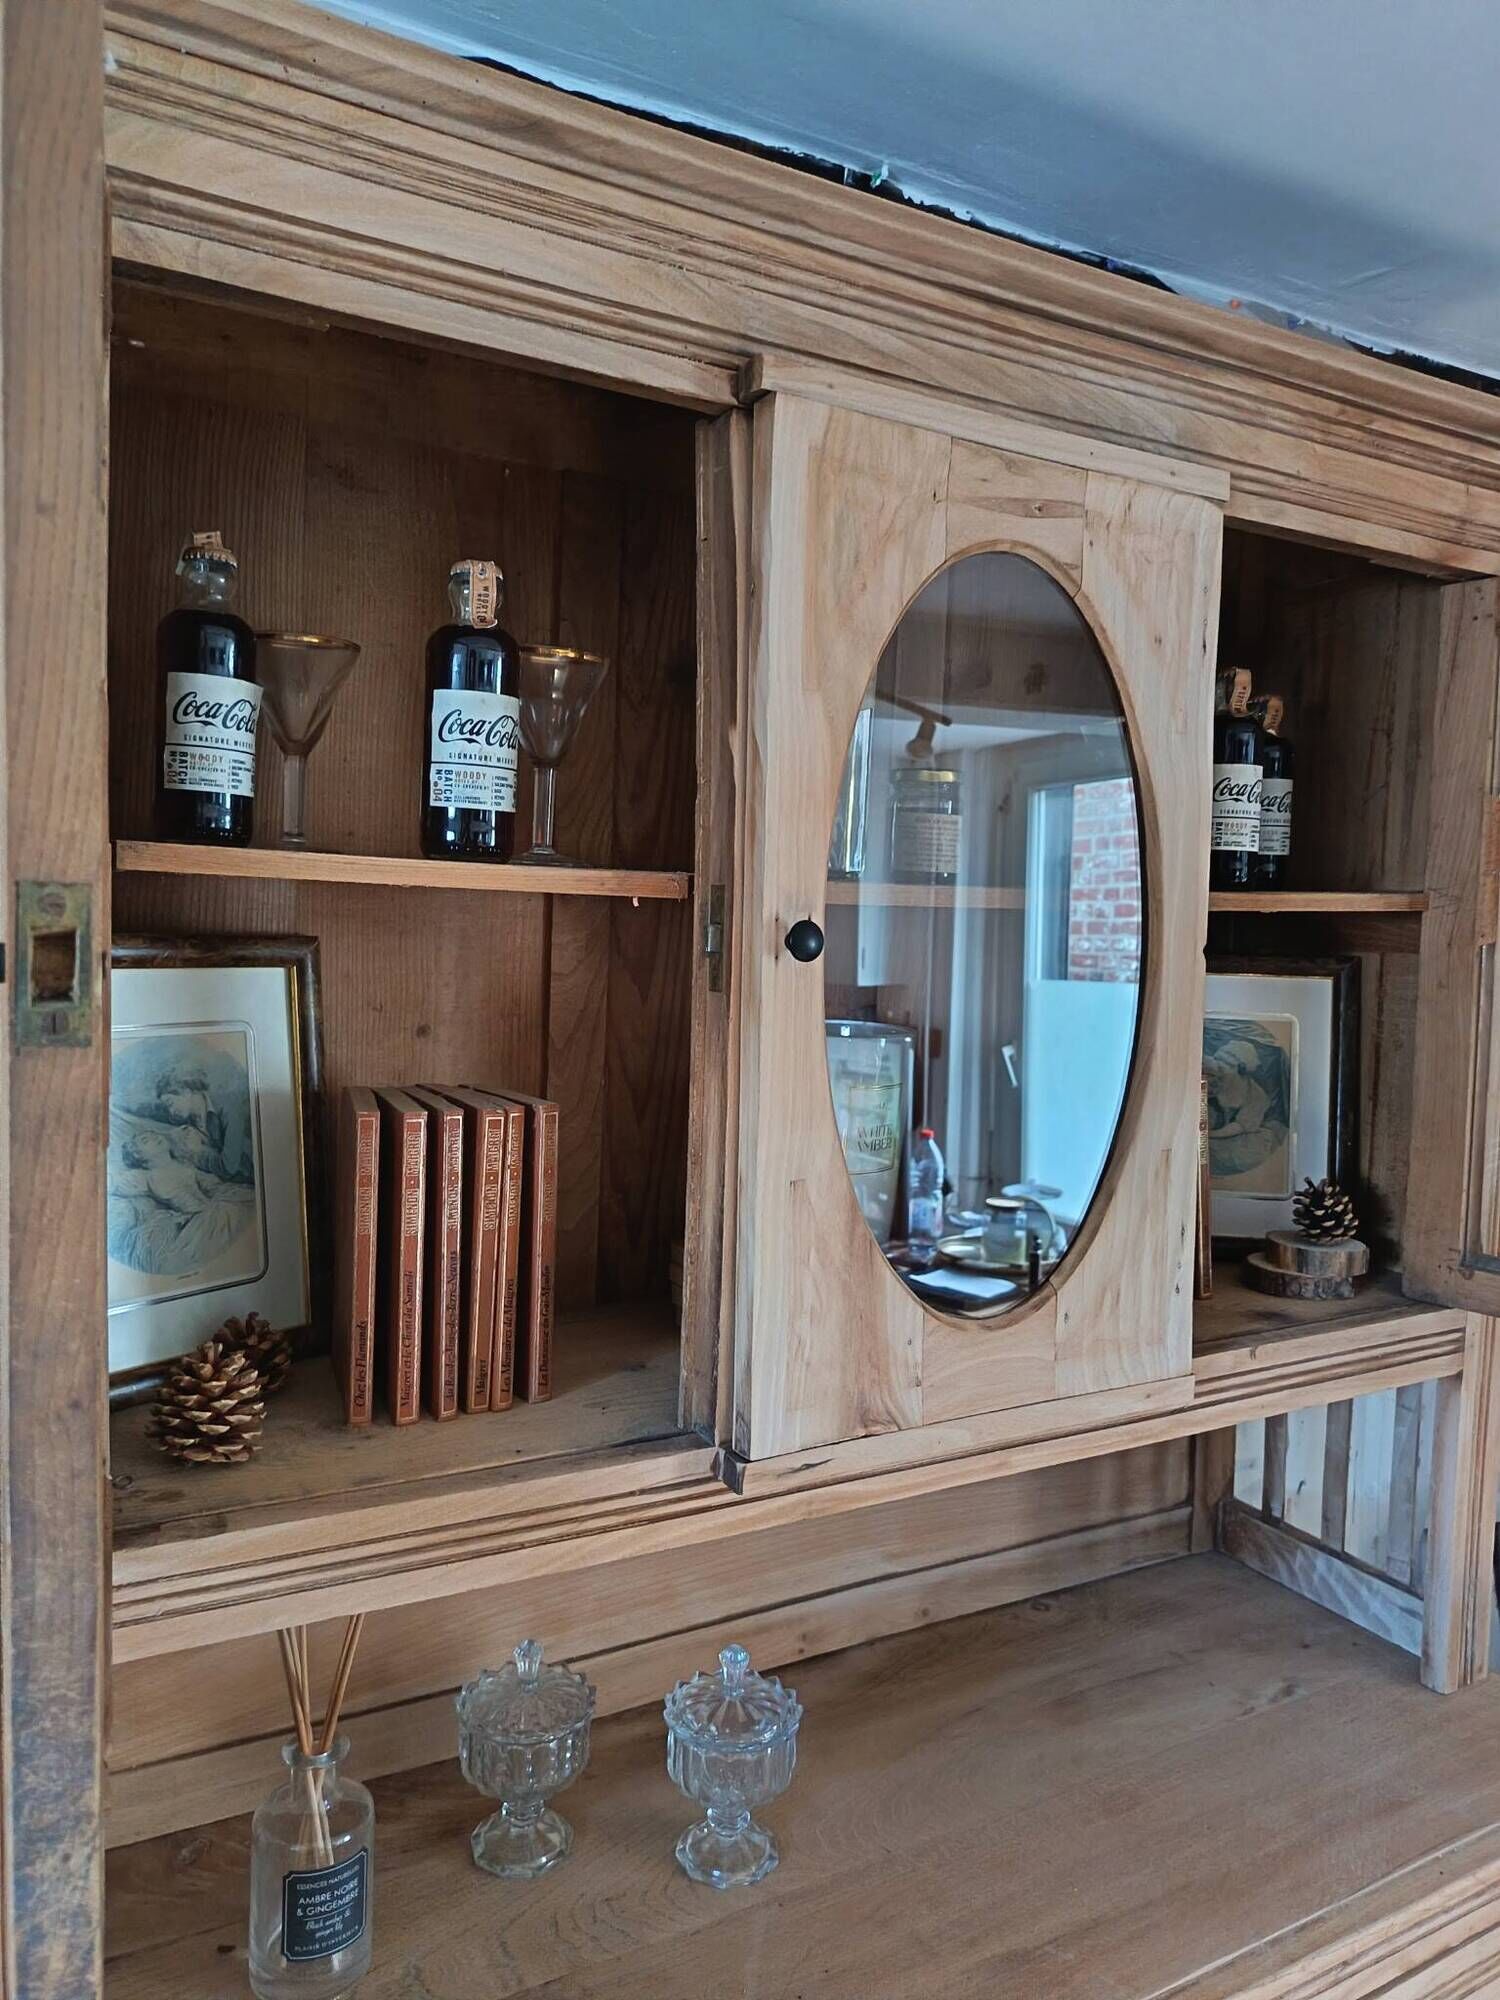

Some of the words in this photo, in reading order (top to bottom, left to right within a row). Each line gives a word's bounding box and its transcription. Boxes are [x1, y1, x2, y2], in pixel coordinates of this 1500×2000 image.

[173, 691, 257, 734] Coca-Cola
[438, 708, 520, 750] Coca-Cola
[178, 751, 188, 785] BATCH
[190, 751, 223, 762] WOODY
[448, 752, 493, 763] SIGNATURE
[443, 769, 454, 802] BATCH
[455, 770, 487, 780] WOODY
[403, 1271, 414, 1306] Samedi
[356, 1320, 368, 1367] Flamands
[403, 1319, 413, 1348] Client
[296, 1907, 304, 1917] &
[306, 1888, 359, 1916] GINGEMBRE
[298, 1892, 332, 1905] AMBRE
